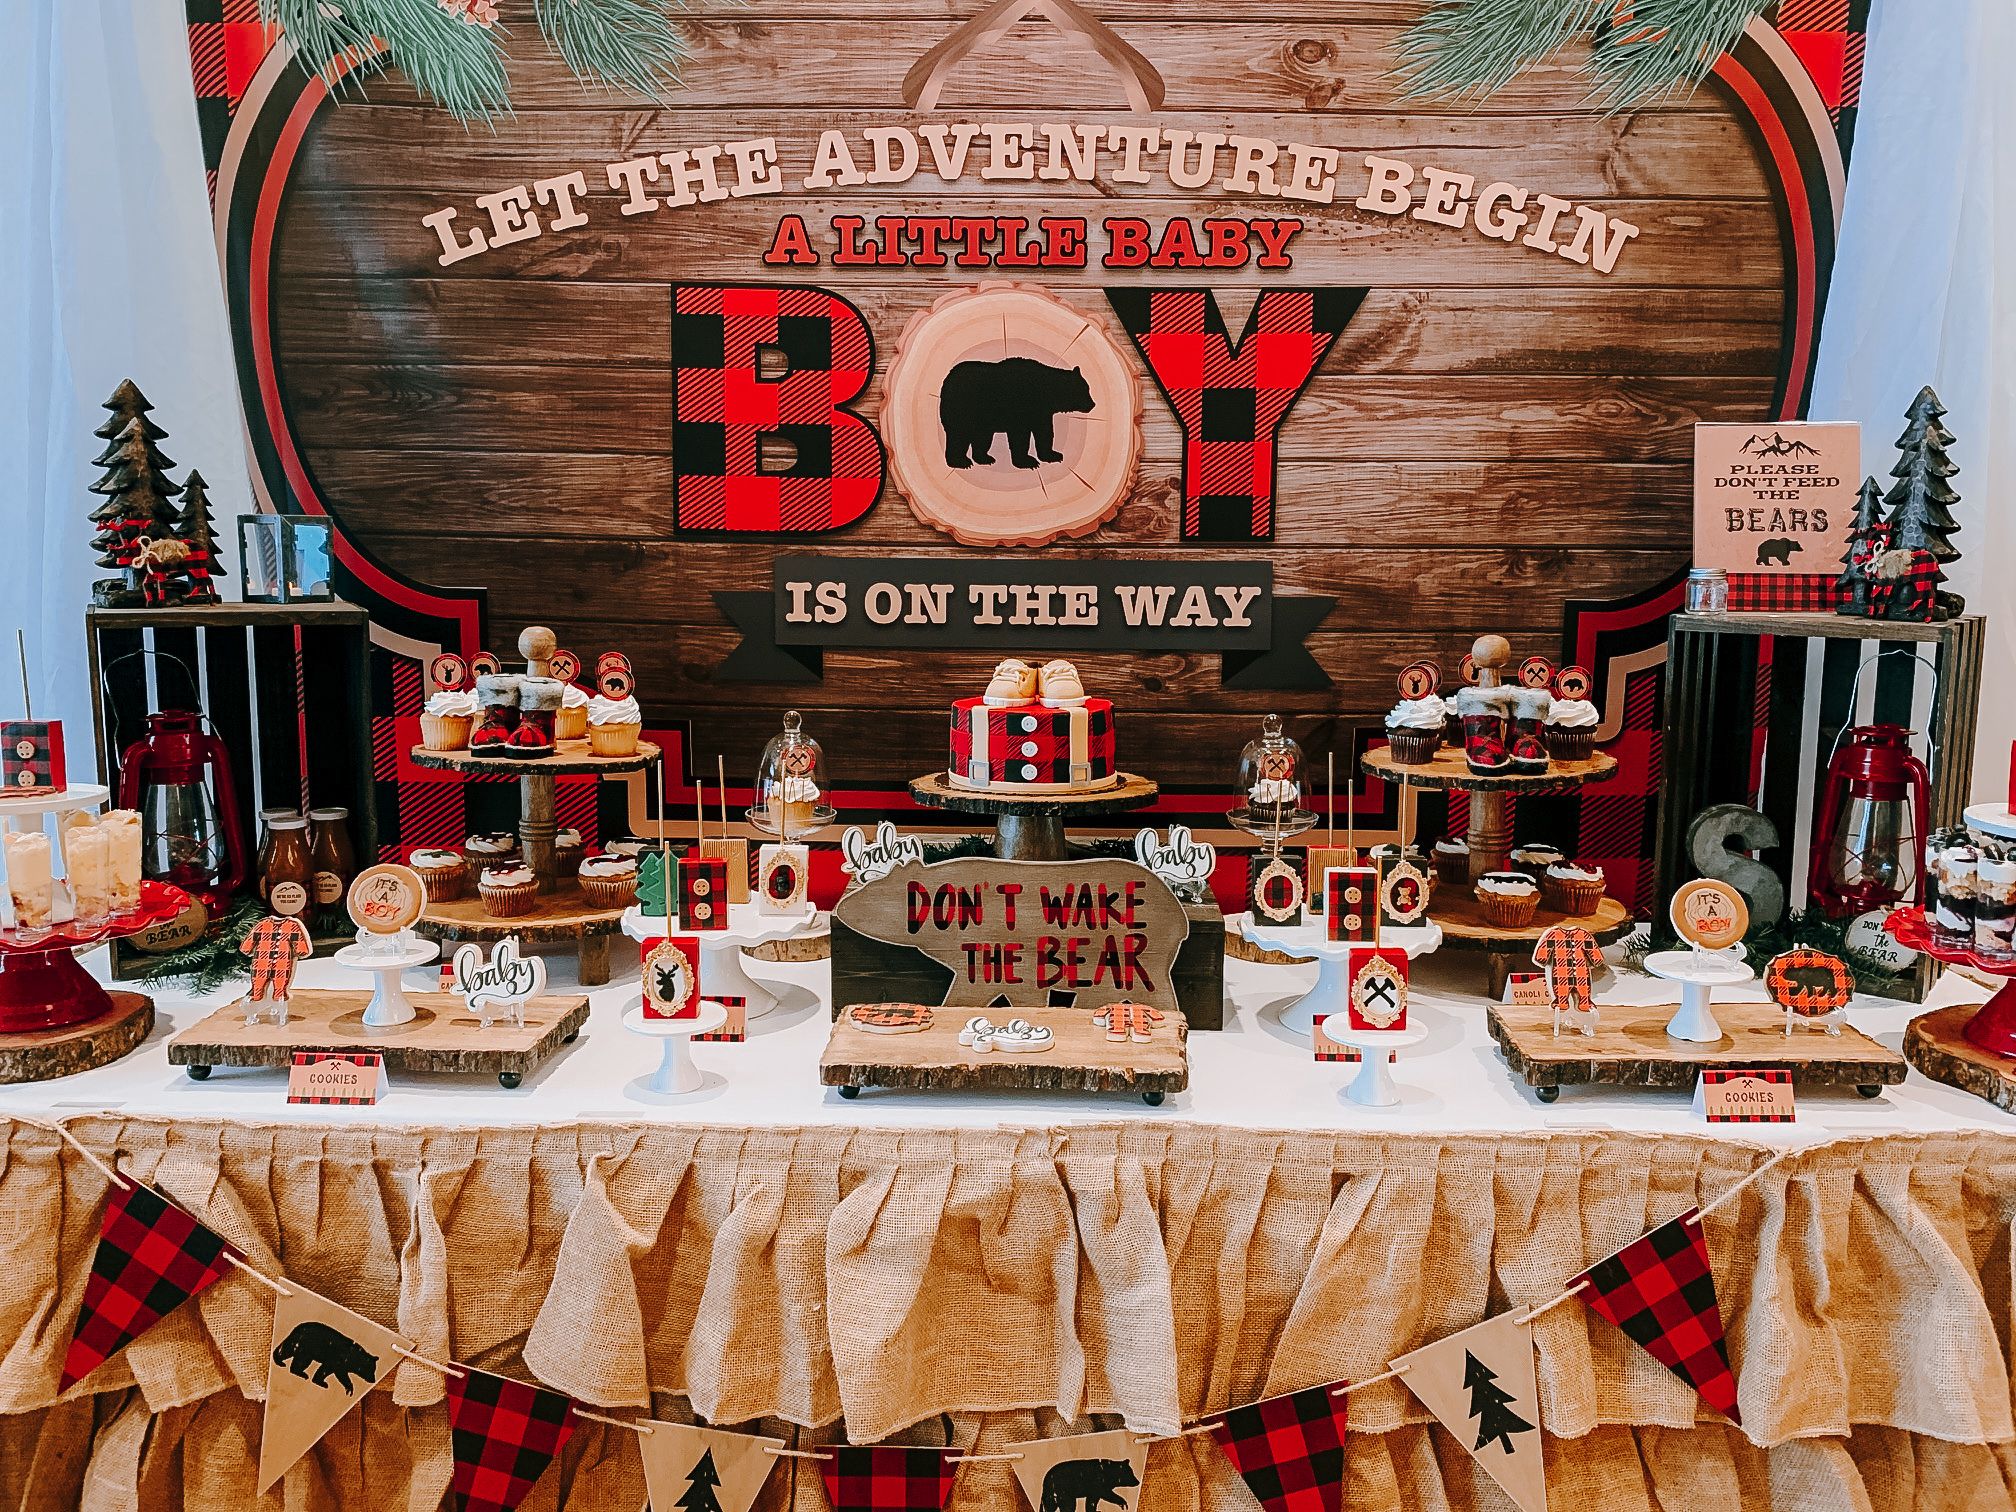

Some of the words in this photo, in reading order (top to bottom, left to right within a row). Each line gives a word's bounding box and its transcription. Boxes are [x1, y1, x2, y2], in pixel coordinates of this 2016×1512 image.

[422, 170, 589, 266] LET
[606, 137, 783, 215] THE
[803, 122, 1339, 204] ADVENTURE
[1355, 155, 1639, 274] BEGIN
[763, 214, 821, 267] A
[830, 215, 1088, 268] LITTLE
[1101, 216, 1304, 269] BABY
[1730, 464, 1819, 475] PLEASE
[1714, 477, 1778, 488] DON'T
[1783, 476, 1840, 488] FEED
[1753, 490, 1800, 500] THE
[1724, 508, 1828, 532] BEARS
[785, 582, 847, 624] IS
[864, 583, 954, 624] ON
[968, 584, 1099, 626] THE
[1114, 585, 1261, 627] WAY
[846, 825, 919, 883] baby
[1141, 829, 1213, 880] baby
[375, 878, 399, 891] IT'S
[378, 891, 388, 903] A
[1697, 893, 1721, 905] IT'S
[364, 902, 401, 920] BOY
[907, 881, 1023, 934] DON'T
[1040, 881, 1147, 930] WAKE
[1707, 905, 1718, 916] A
[145, 925, 192, 944] BEAR
[1696, 918, 1731, 933] BOY
[1874, 933, 1890, 948] the
[962, 943, 1024, 984] THE
[1036, 933, 1155, 992] BEAR
[1859, 945, 1898, 963] BEAR
[456, 944, 535, 1008] baby
[967, 1017, 1051, 1042] baby
[309, 1073, 358, 1085] COOKIES
[1725, 1091, 1774, 1103] COOKIES
